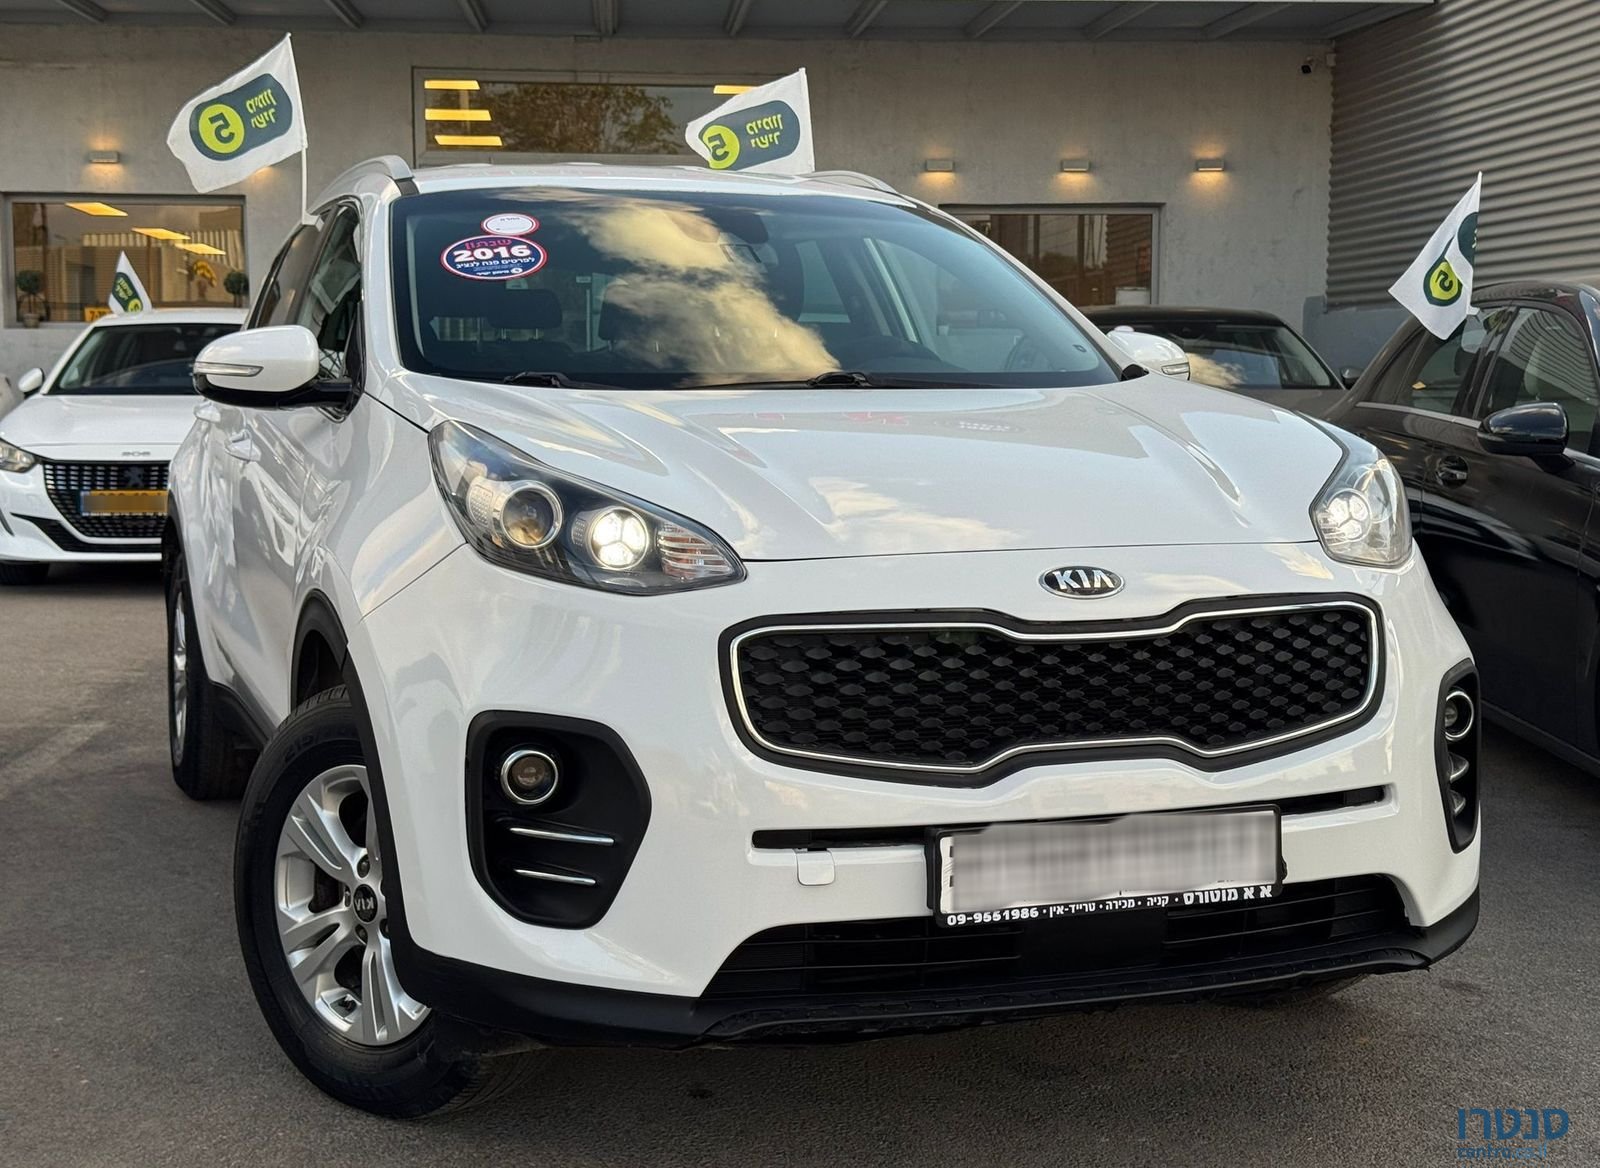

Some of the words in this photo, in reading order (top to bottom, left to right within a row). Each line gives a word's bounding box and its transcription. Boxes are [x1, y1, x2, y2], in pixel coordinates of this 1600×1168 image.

[453, 245, 531, 263] 2016
[501, 257, 535, 265] לפרטים
[1052, 569, 1115, 589] KIA
[1182, 889, 1239, 905] מוטורס
[1242, 887, 1255, 900] א
[1259, 884, 1273, 898] א
[1105, 899, 1135, 911] מכירה
[1146, 895, 1169, 907] קניה
[1048, 903, 1096, 918] טרייד-אין
